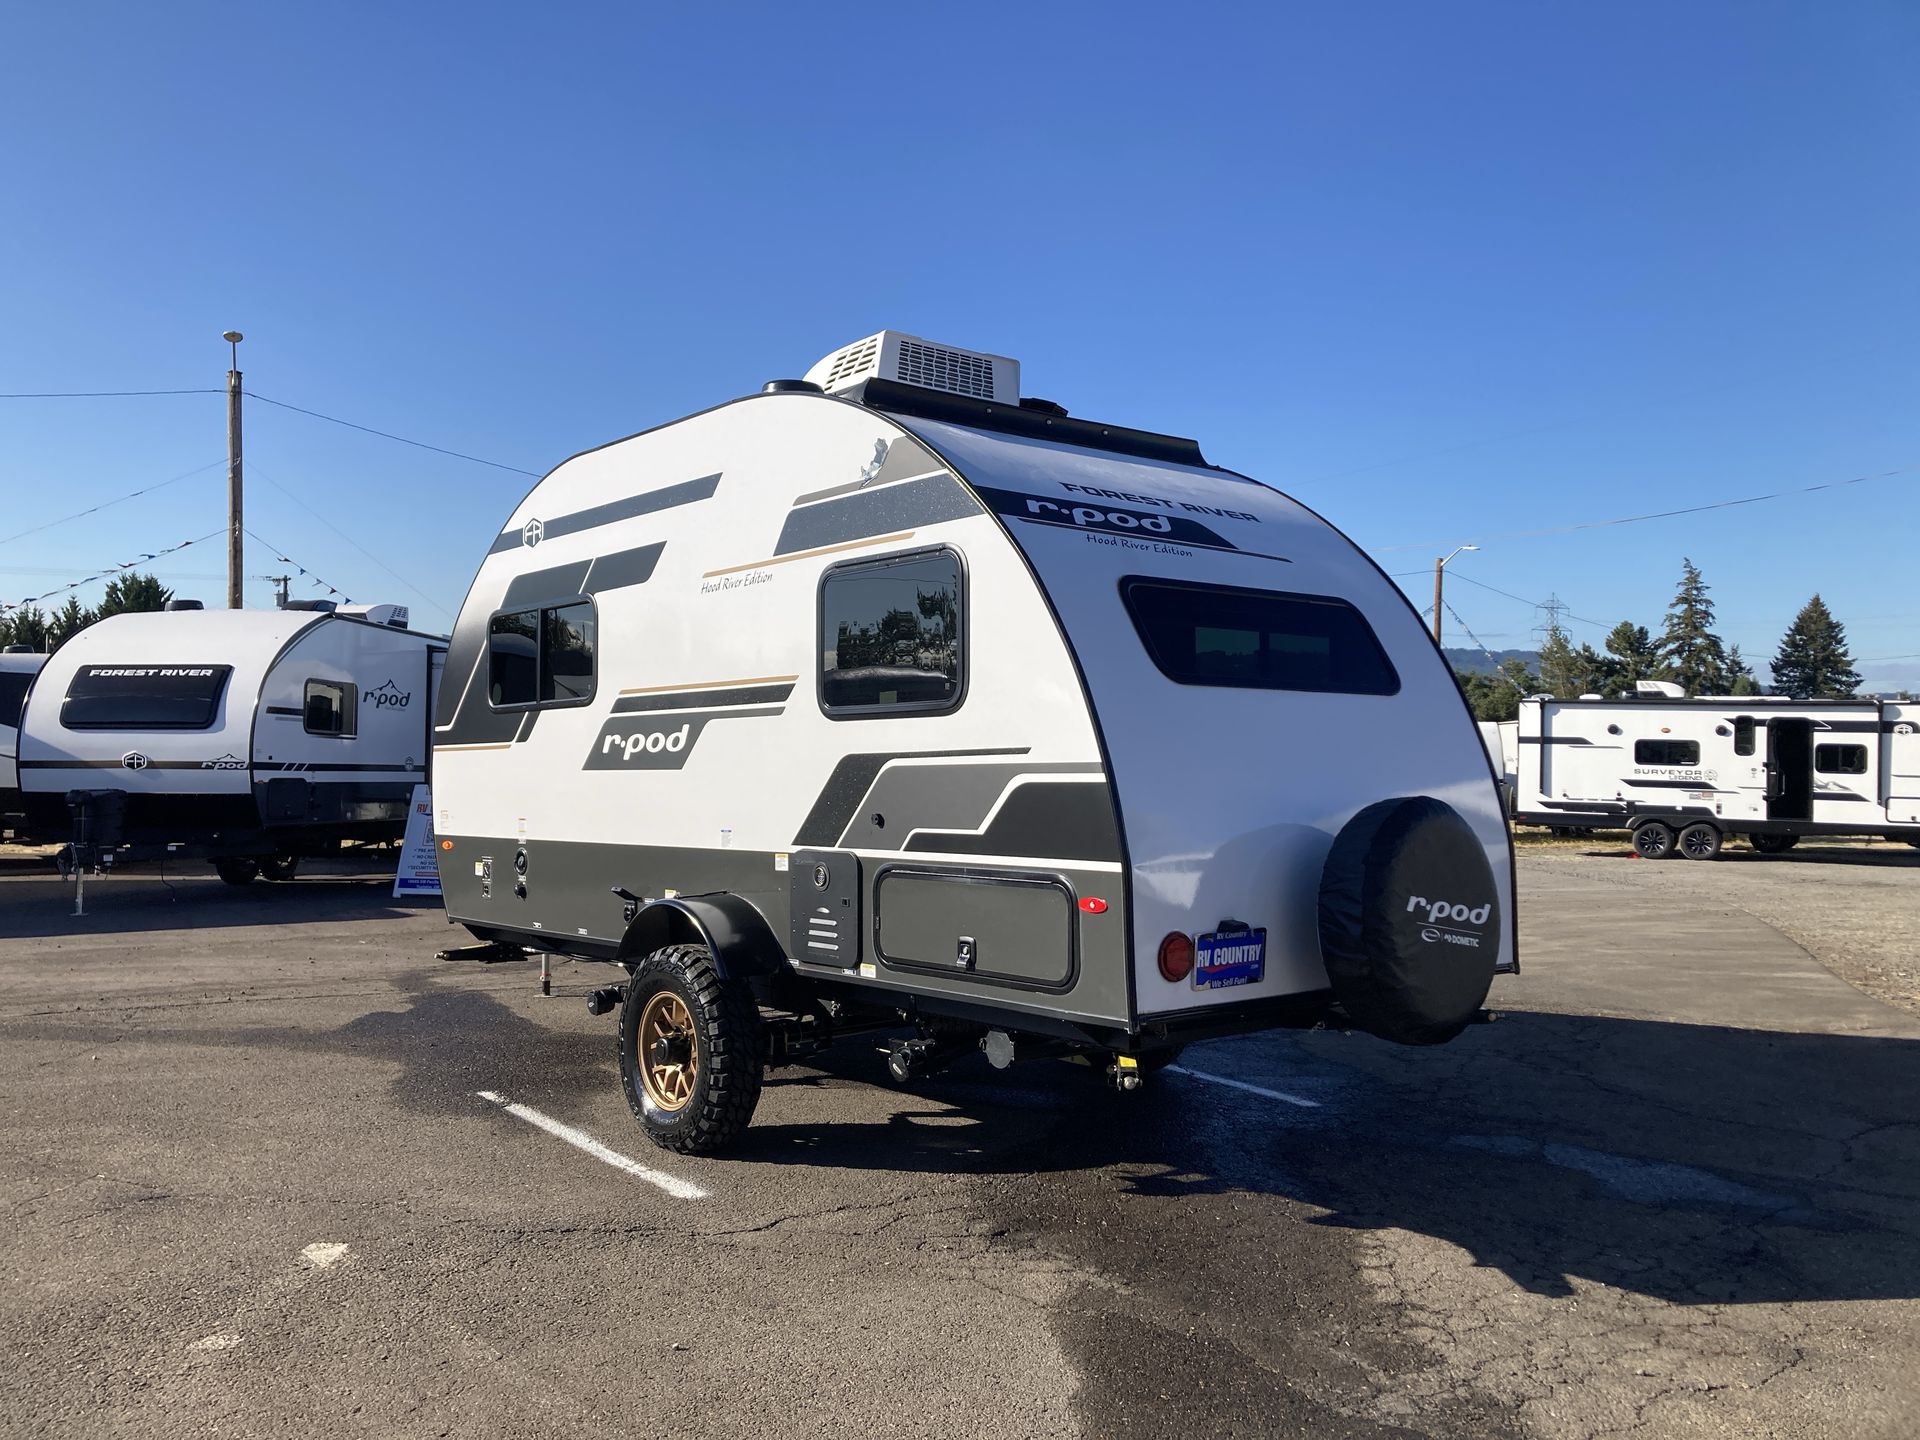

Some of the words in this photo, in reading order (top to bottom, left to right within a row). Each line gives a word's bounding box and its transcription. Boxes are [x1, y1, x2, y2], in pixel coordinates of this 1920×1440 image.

[1058, 481, 1174, 509] FOREST
[1179, 502, 1263, 524] RIVER
[1086, 534, 1118, 547] Hood
[1120, 538, 1151, 552] River
[1154, 543, 1193, 558] Edition
[701, 577, 722, 594] Hood
[722, 577, 743, 590] River
[744, 570, 773, 587] Edition
[89, 669, 158, 677] FOREST
[160, 669, 213, 677] RIVER
[1634, 768, 1703, 776] SURVEYOR
[1216, 932, 1224, 940] RV
[1452, 934, 1480, 948] DOMETIC
[1197, 949, 1211, 968] RV
[1213, 944, 1262, 966] COUNTRY
[1222, 978, 1233, 987] Sell
